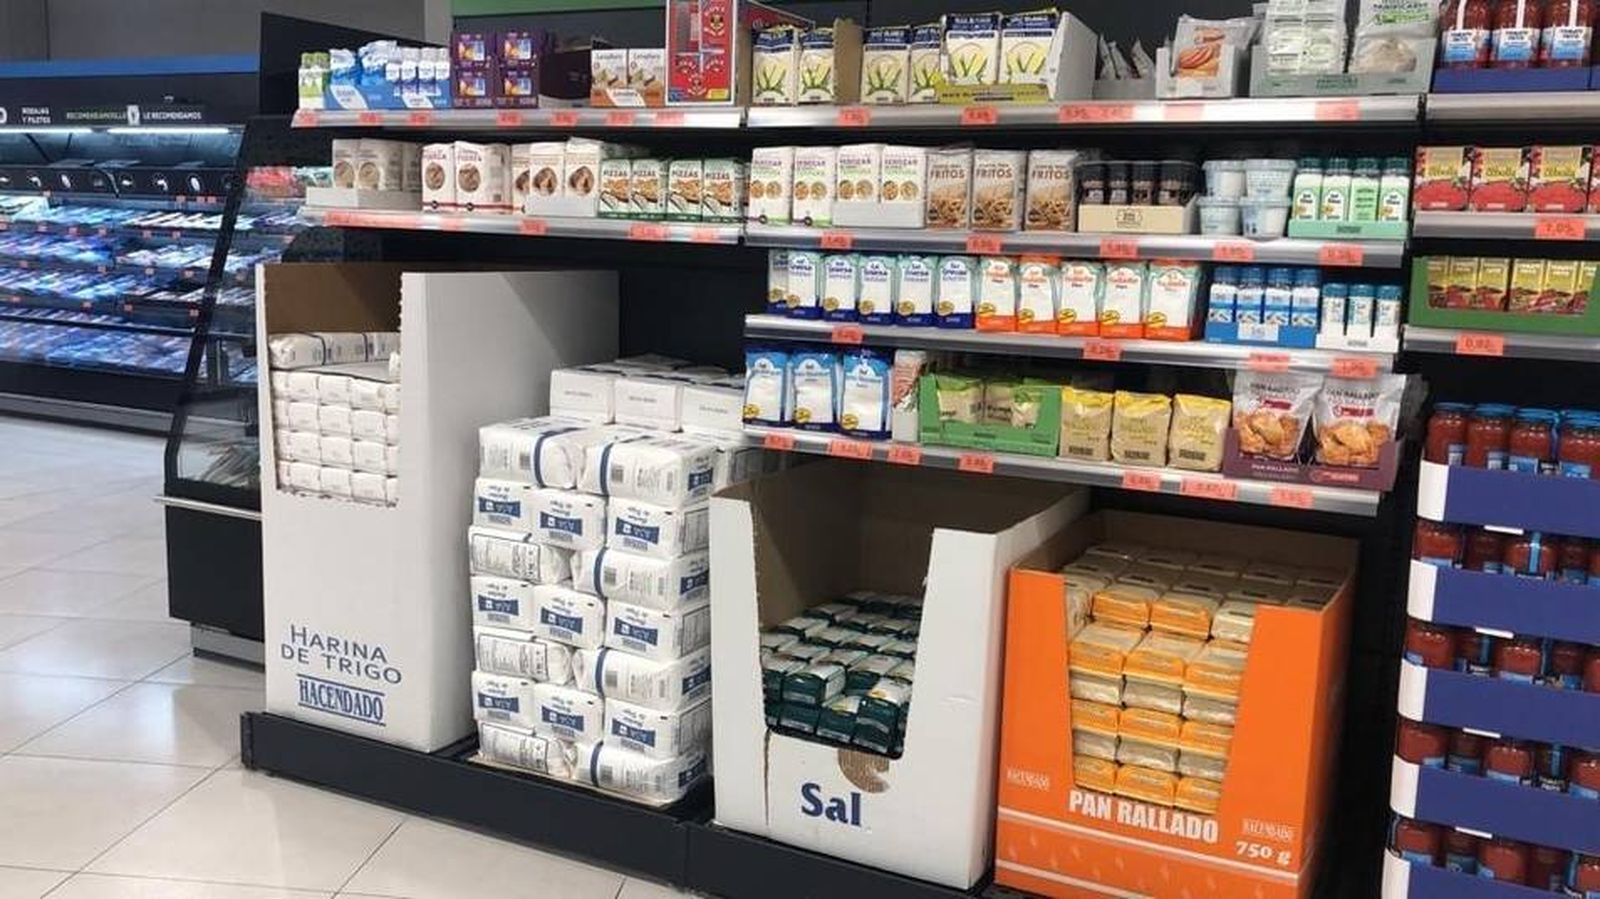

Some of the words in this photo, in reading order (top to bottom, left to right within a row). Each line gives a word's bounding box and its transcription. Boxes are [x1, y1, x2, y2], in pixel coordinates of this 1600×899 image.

[930, 169, 965, 180] FRITOS
[976, 168, 1012, 179] FRITOS
[1031, 170, 1071, 180] FRITOS
[281, 643, 309, 665] DE
[321, 652, 402, 685] TRIGO
[291, 623, 388, 664] HARINA
[299, 679, 384, 721] HACENDADO
[801, 782, 861, 827] Sal
[1068, 789, 1112, 820] PAN
[1115, 799, 1219, 844] RALLADO
[1235, 840, 1273, 859] 750
[1277, 851, 1292, 866] g
